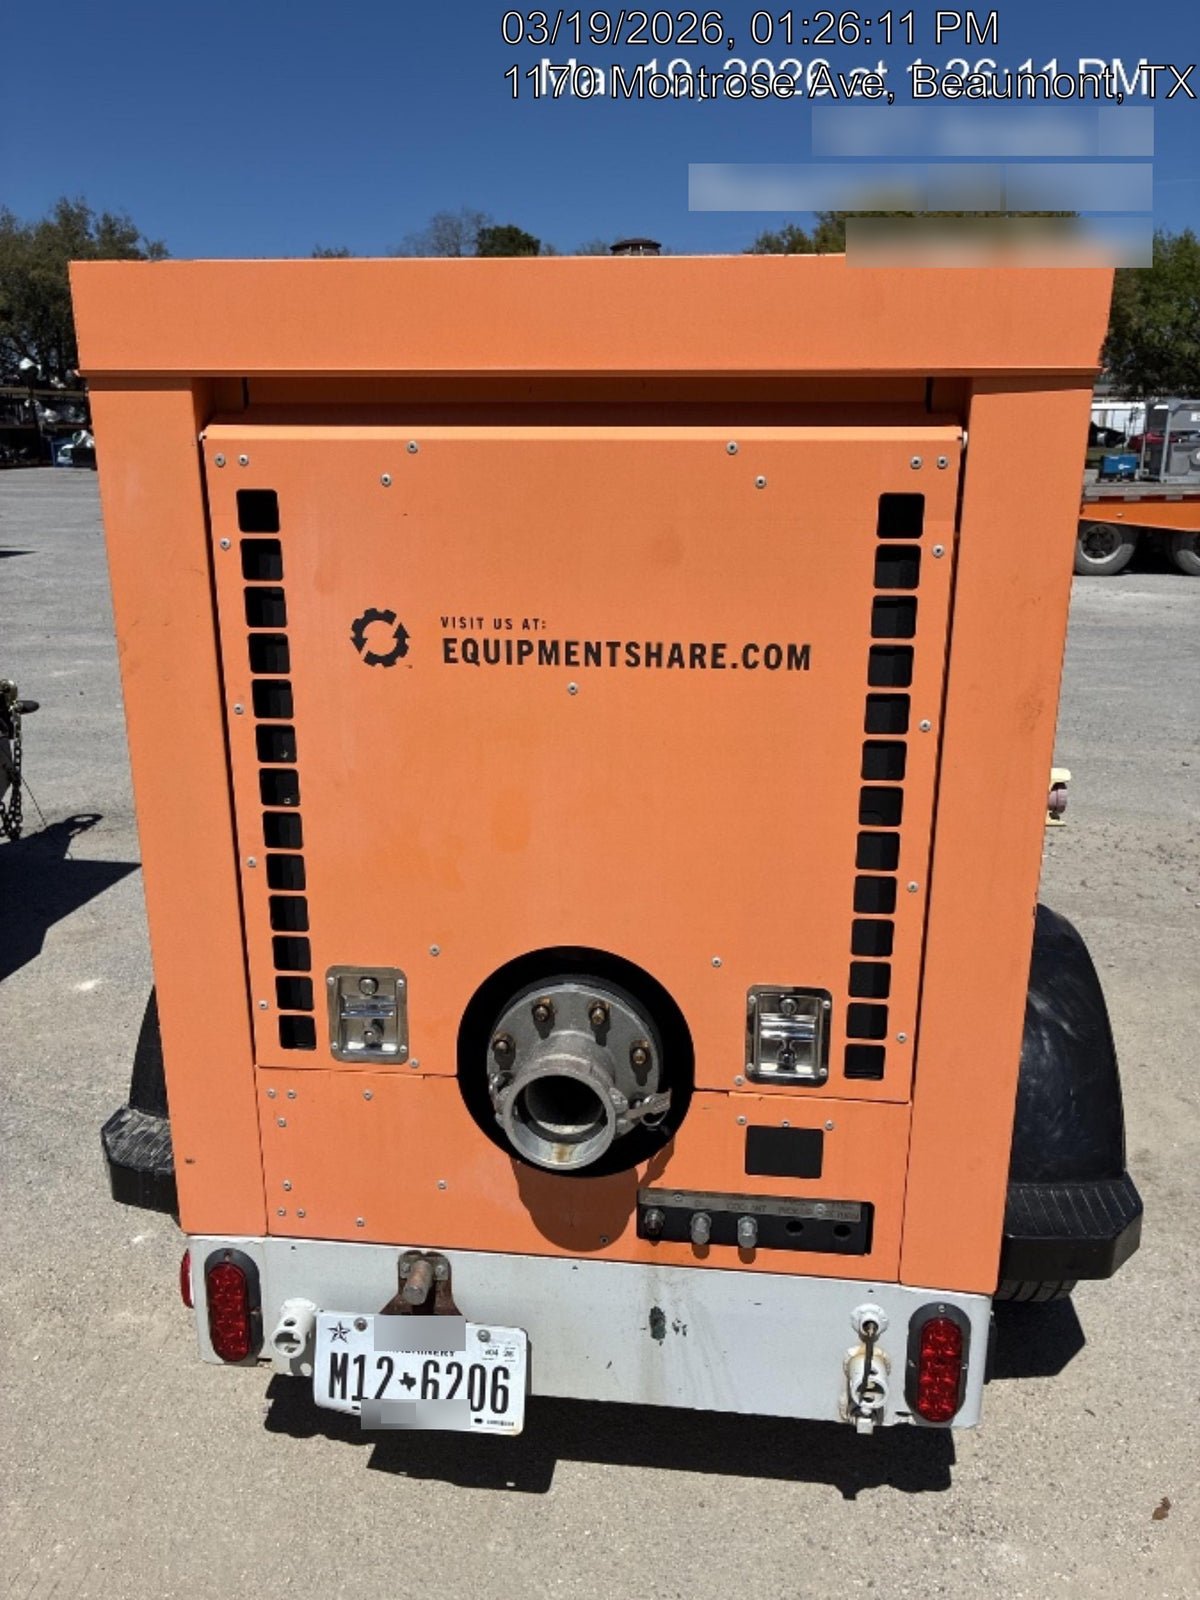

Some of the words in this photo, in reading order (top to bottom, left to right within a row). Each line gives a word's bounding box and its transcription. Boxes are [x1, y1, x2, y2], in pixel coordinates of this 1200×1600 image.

[440, 616, 484, 630] VISIT
[493, 618, 513, 630] US
[521, 618, 546, 630] AT:
[442, 638, 811, 671] EQUIPMENTSHARE.COM
